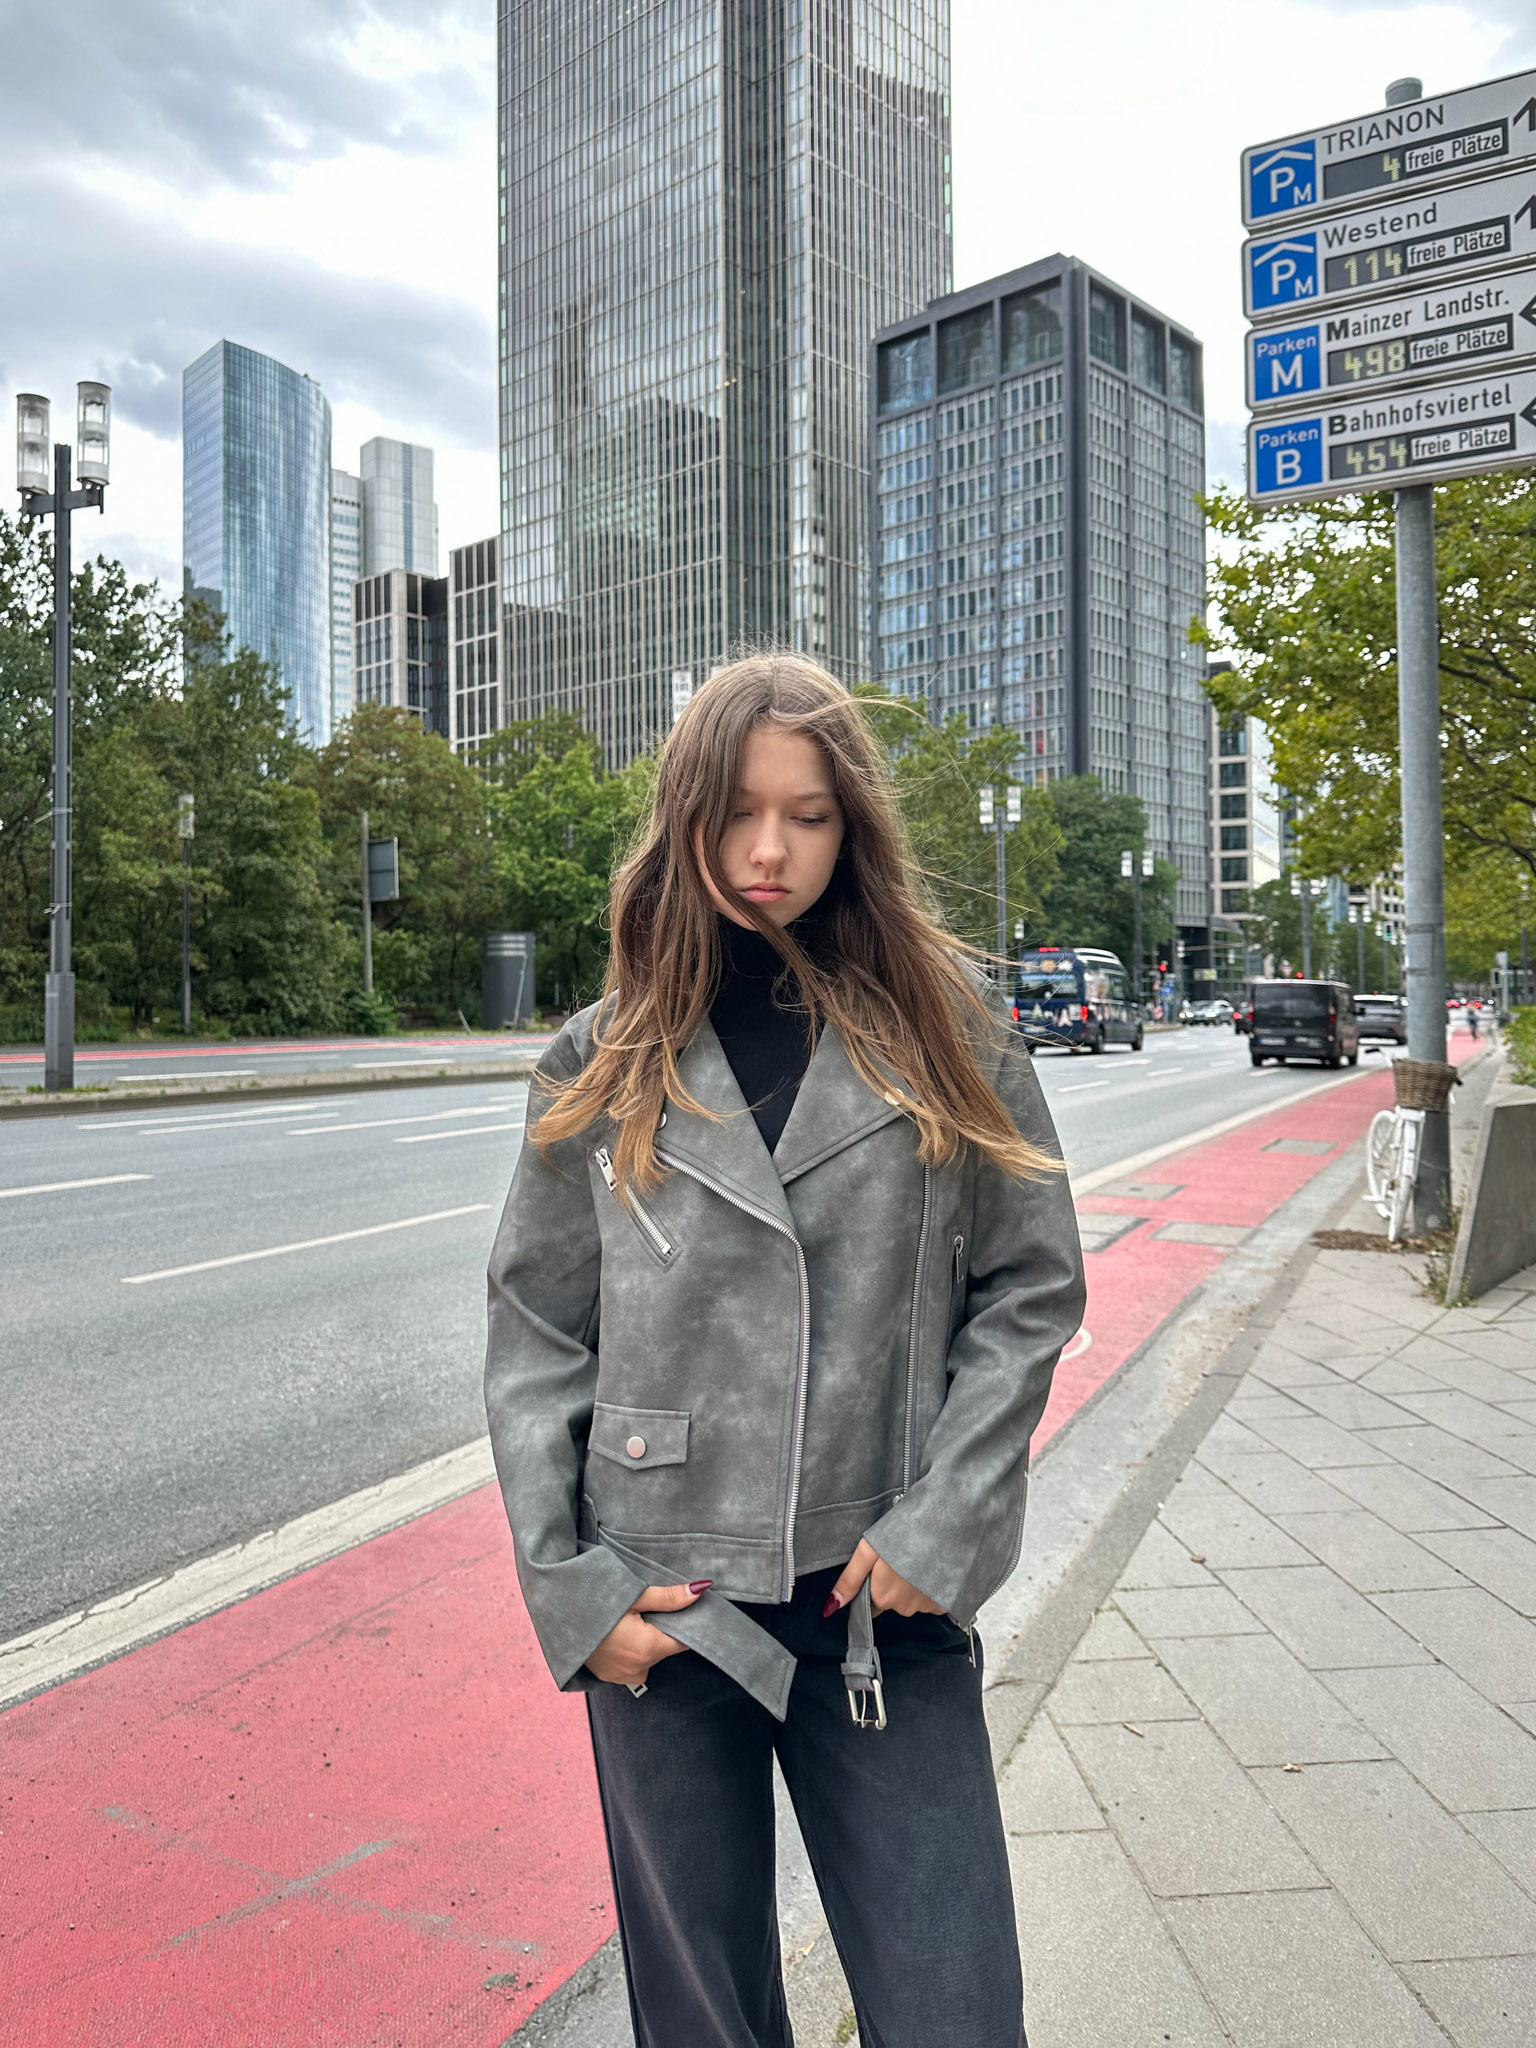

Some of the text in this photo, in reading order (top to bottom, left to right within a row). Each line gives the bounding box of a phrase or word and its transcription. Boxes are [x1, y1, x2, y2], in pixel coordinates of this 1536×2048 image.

[1321, 104, 1444, 155] TRIANON
[1383, 153, 1400, 182] 4
[1408, 130, 1501, 170] freie Plätze
[1270, 166, 1312, 205] P M
[1323, 202, 1437, 249] Westend
[1409, 228, 1503, 265] freie Plätze
[1271, 258, 1313, 298] P M
[1344, 249, 1403, 286] 114
[1326, 288, 1510, 342] Mainzer Landstr.
[1256, 336, 1317, 358] Parken
[1344, 339, 1406, 380] 498
[1412, 325, 1506, 361] freie Plätze
[1271, 353, 1303, 393] M
[1328, 383, 1512, 436] Bahnhofsviertel
[1258, 428, 1319, 449] Parken
[1346, 439, 1408, 476] 454
[1414, 425, 1508, 459] freie Plätze
[1275, 448, 1302, 485] B
